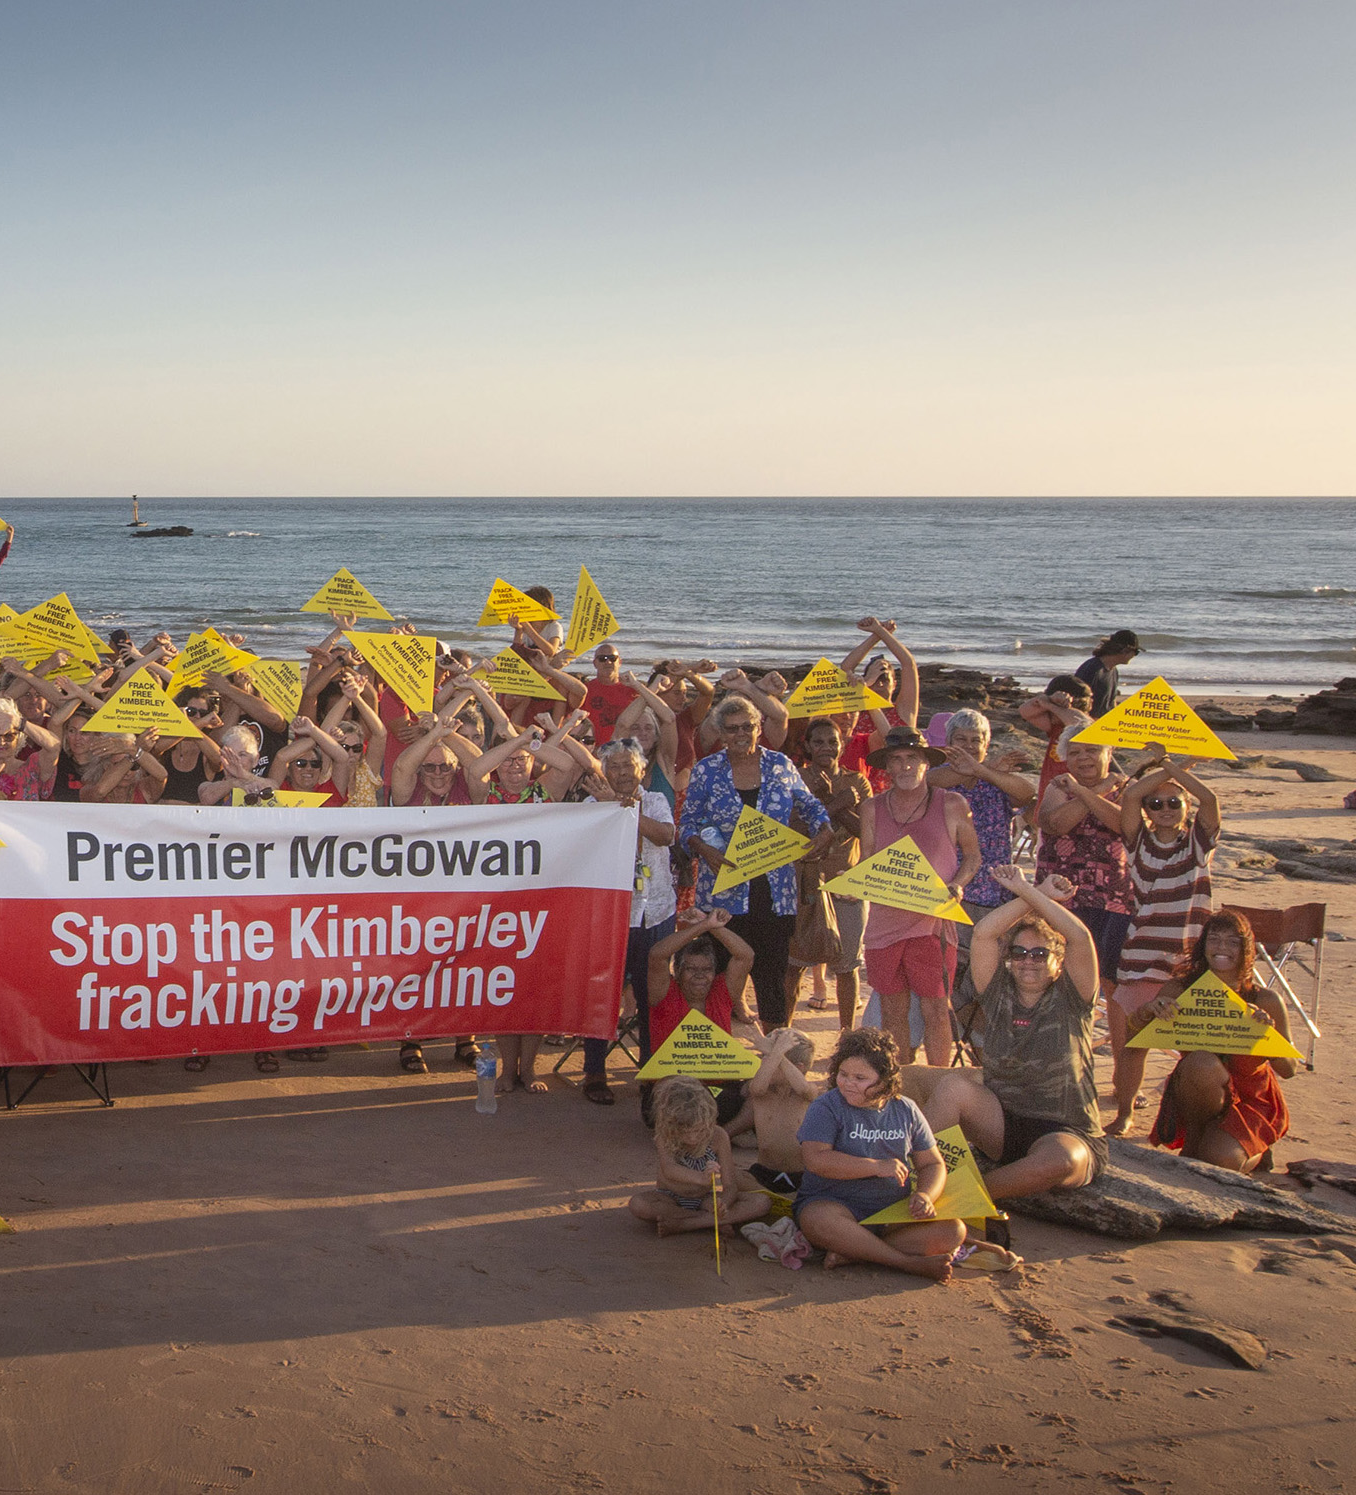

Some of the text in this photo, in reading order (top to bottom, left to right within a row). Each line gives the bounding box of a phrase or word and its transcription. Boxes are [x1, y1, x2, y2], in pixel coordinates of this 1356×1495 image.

[45, 602, 71, 614] FRACK
[46, 609, 66, 620] FREE
[32, 612, 75, 631] KIMBERLEY
[405, 644, 425, 665] FREE
[409, 637, 433, 662] FRACK
[390, 639, 428, 680] KIMBERLEY
[128, 681, 155, 690] FRACK
[131, 690, 152, 698] FREE
[1138, 691, 1175, 702] FRACK
[119, 697, 164, 707] KIMBERLEY
[1142, 701, 1170, 711] FREE
[1123, 707, 1186, 722] KIMBERLEY
[1117, 720, 1149, 729] Protect
[1167, 725, 1190, 734] Water
[738, 815, 765, 832] FRACK
[68, 832, 540, 881] Premier McGowan
[886, 848, 921, 862] FRACK
[888, 857, 915, 870] FREE
[870, 862, 929, 882] KIMBERLEY
[49, 904, 548, 978] Stop the Kimberley
[76, 956, 515, 1033] fracking pipeline
[1190, 988, 1228, 998] FRACK
[1195, 998, 1224, 1008] FREE
[1177, 1007, 1243, 1019] KIMBERLEY
